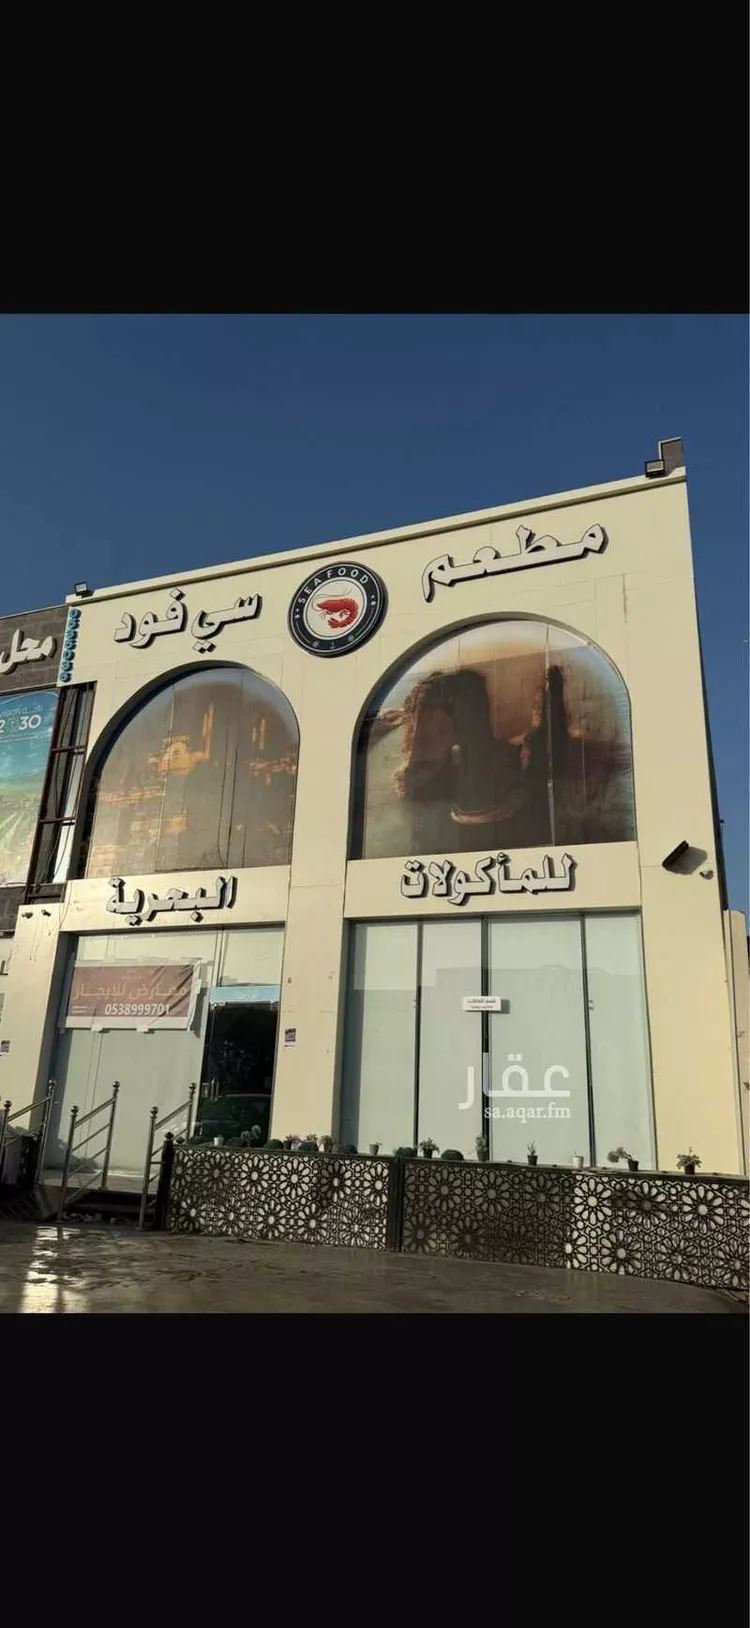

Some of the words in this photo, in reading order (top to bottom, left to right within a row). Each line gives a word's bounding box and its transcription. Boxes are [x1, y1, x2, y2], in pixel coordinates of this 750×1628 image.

[422, 523, 608, 602] مطعم
[114, 588, 187, 648] فود
[191, 594, 262, 653] سي
[105, 876, 238, 926] البحرية
[401, 852, 577, 906] للمأكولات
[104, 1003, 170, 1016] 0538999701
